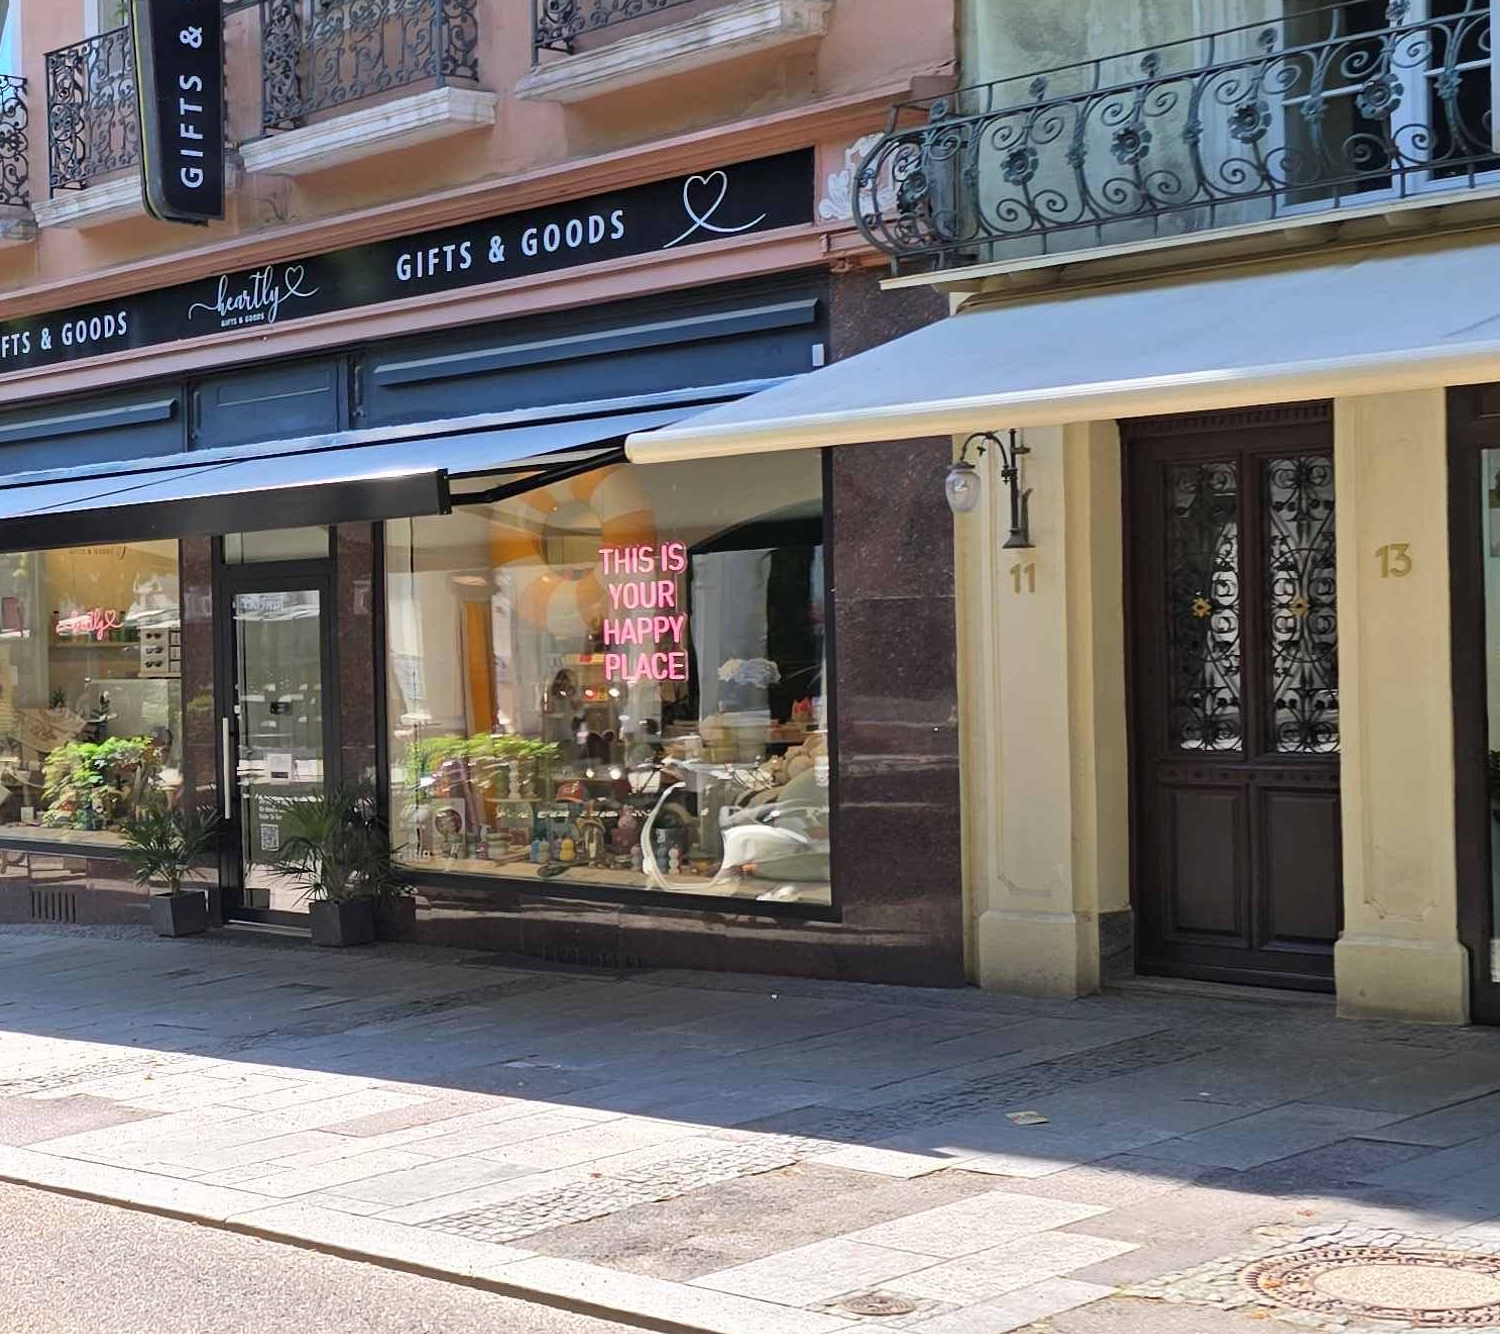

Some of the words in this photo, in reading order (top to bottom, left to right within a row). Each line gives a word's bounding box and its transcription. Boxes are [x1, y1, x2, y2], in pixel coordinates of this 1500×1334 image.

[179, 26, 204, 50] &
[179, 75, 205, 189] GIFTS
[395, 239, 473, 282] GIFTS
[487, 234, 507, 262] &
[520, 208, 627, 257] GOODS
[190, 265, 284, 324] heartly
[39, 325, 53, 351] &
[60, 309, 129, 346] GOODS
[598, 545, 655, 575] THIS
[659, 540, 687, 572] IS
[1375, 542, 1413, 578] 13
[608, 580, 677, 610] YOUR
[1009, 562, 1037, 594] 11
[602, 613, 687, 646] HAPPY
[604, 650, 688, 681] PLACE
